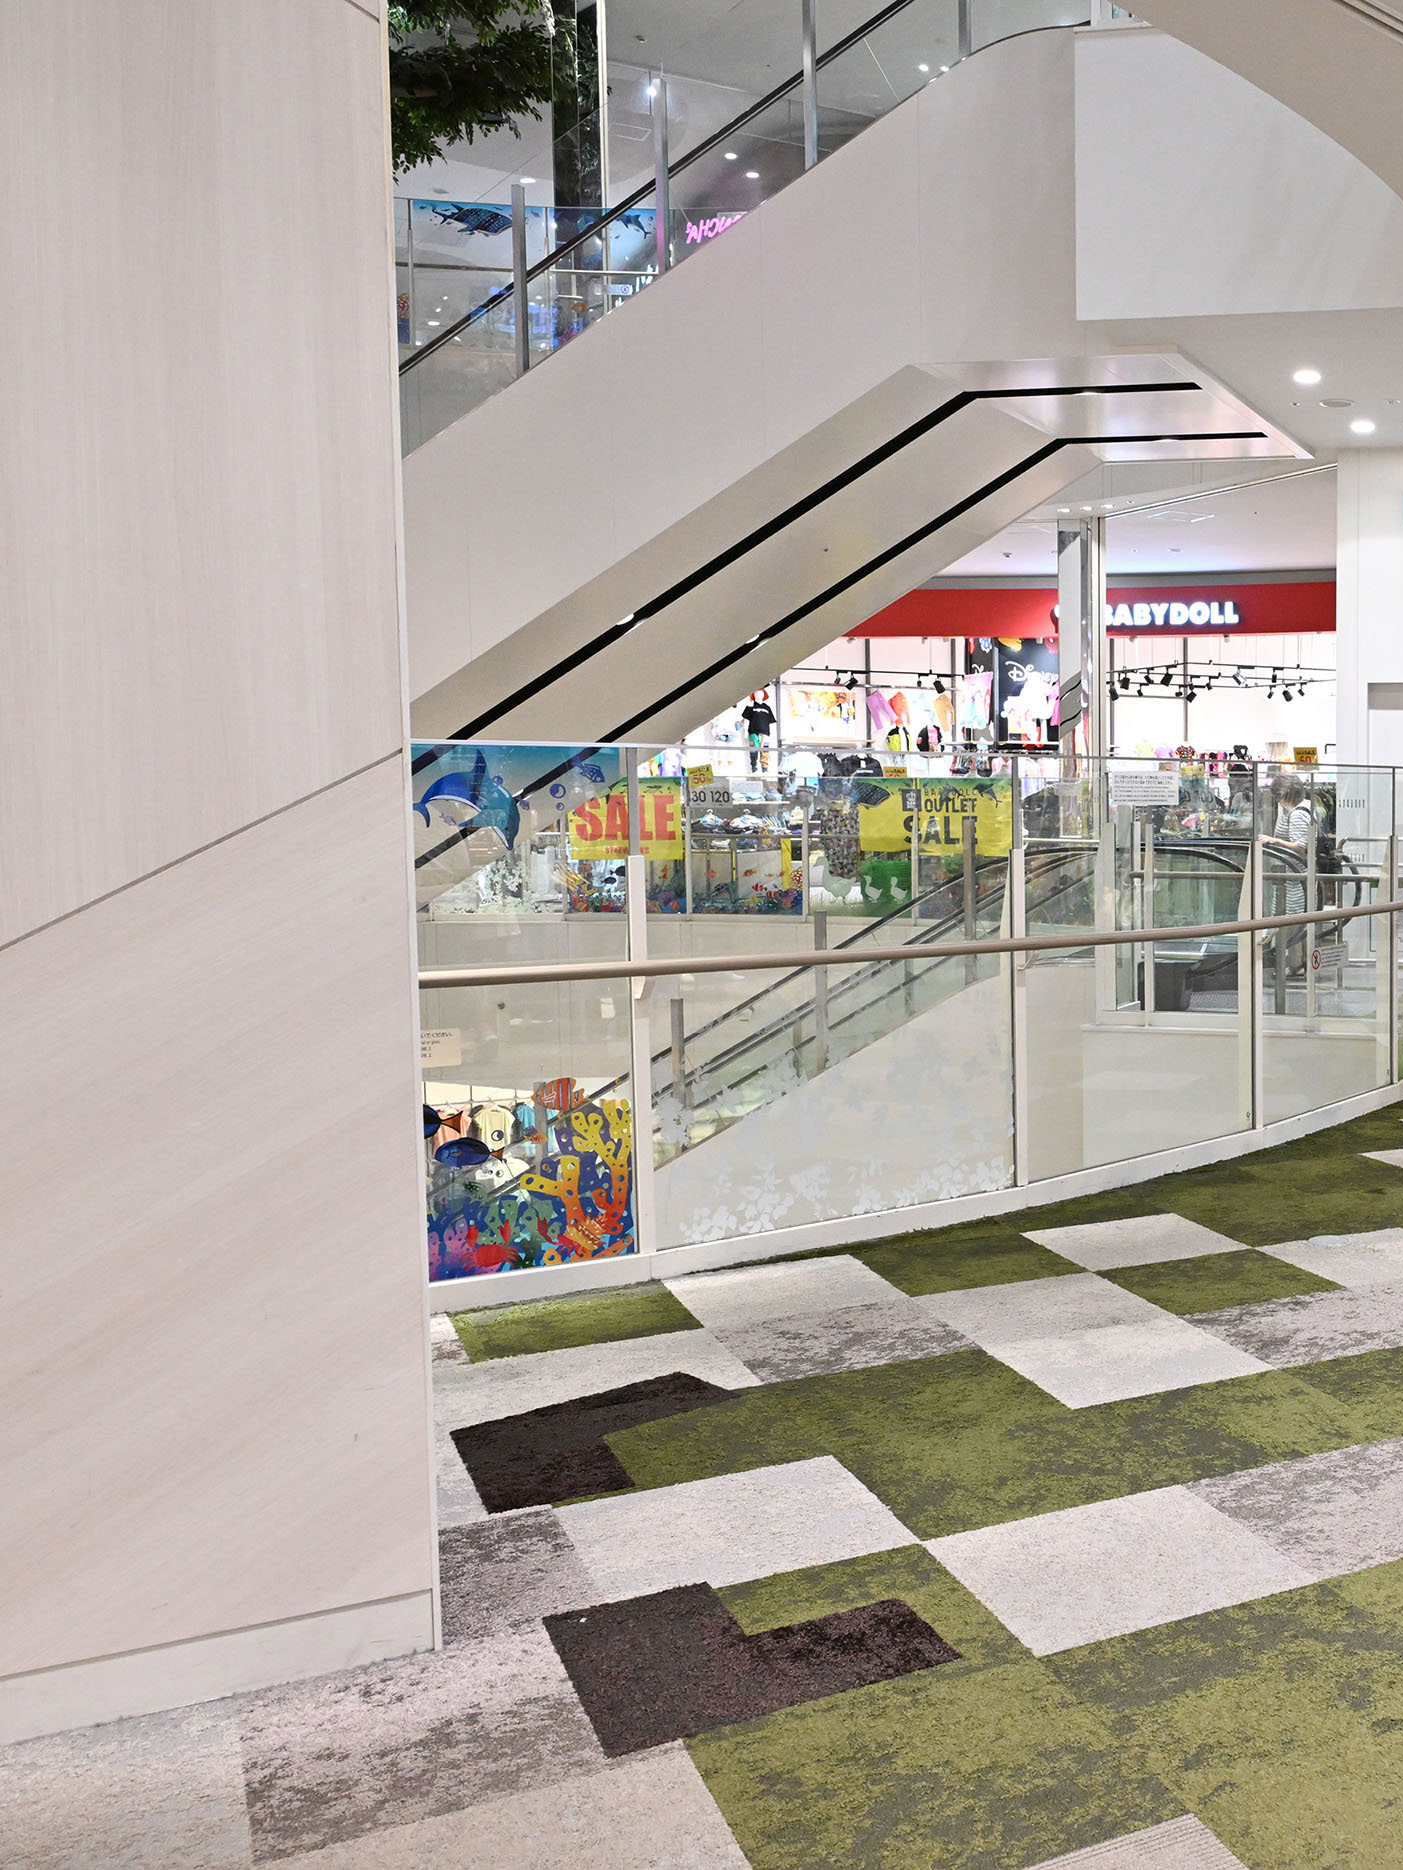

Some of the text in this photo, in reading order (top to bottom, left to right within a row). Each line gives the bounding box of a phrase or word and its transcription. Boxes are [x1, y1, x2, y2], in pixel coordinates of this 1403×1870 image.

[688, 790, 730, 803] 30 120
[924, 797, 978, 814] OUTLET
[575, 795, 676, 841] SALE
